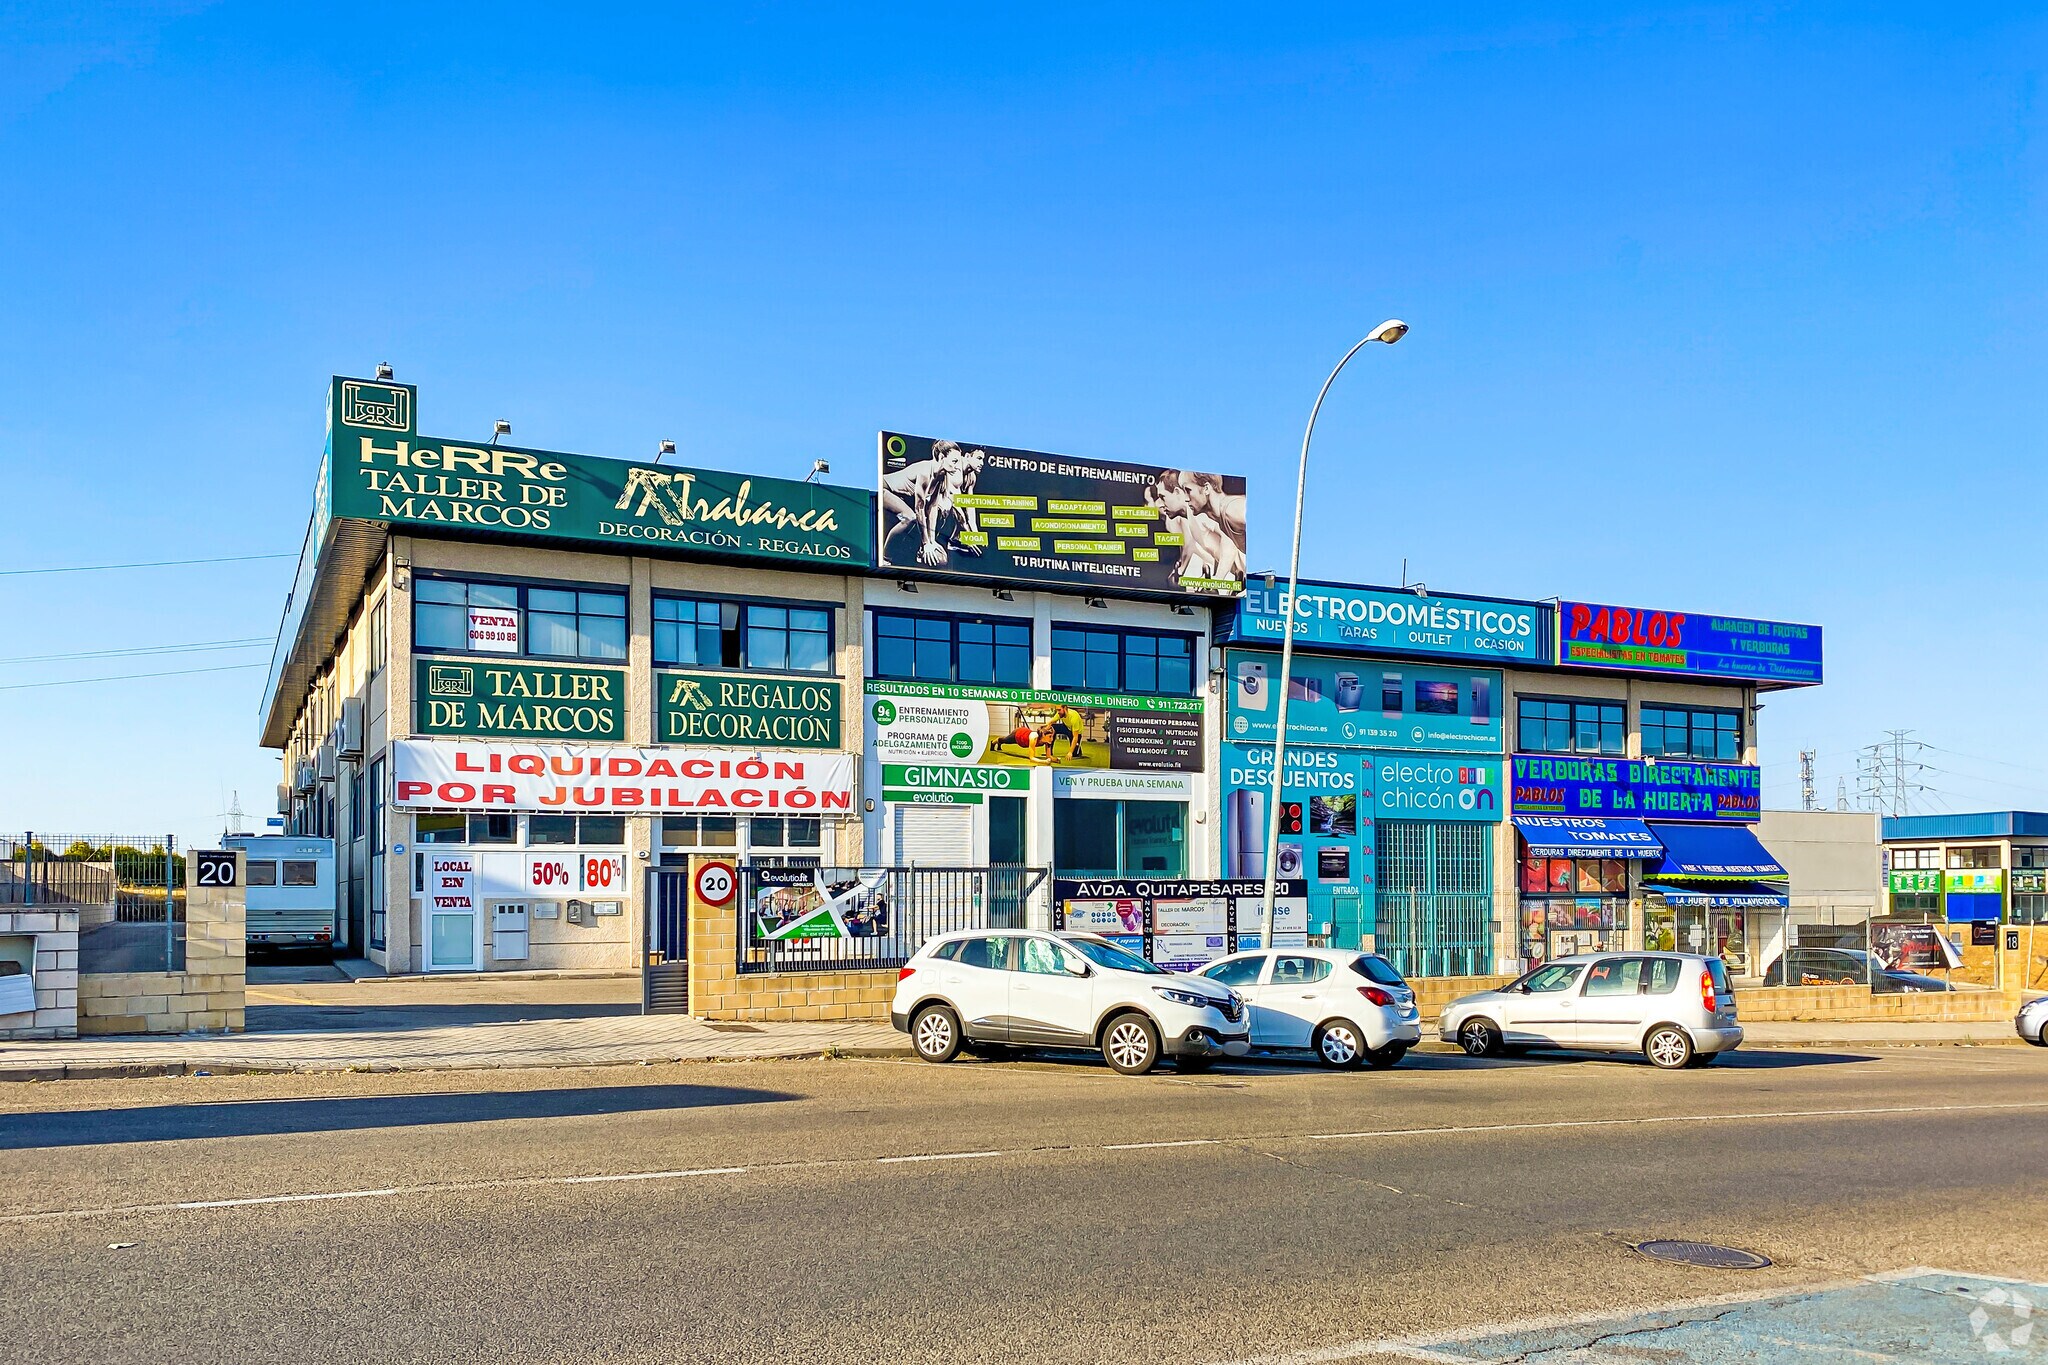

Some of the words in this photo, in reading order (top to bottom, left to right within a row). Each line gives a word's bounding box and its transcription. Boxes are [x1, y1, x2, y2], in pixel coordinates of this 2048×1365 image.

[359, 437, 568, 482] HeRRe
[988, 455, 1037, 472] CENTRO
[1039, 463, 1056, 474] DE
[1058, 464, 1155, 486] ENTRENAMIENTO
[360, 468, 507, 501] TALLER
[519, 484, 568, 508] DE
[956, 497, 1001, 507] FUNCTIONAL
[1002, 499, 1035, 508] TRAINING
[378, 494, 551, 530] MARCOS
[1114, 510, 1157, 518] KETTLEBELL
[982, 517, 1011, 526] FUERZA
[1118, 527, 1147, 535] PILATES
[598, 521, 742, 549] DECORACIÓN
[758, 538, 851, 559] REGALOS
[963, 534, 985, 543] YOGA
[1000, 540, 1038, 549] MOVILIDAD
[1056, 543, 1092, 551] PERSONAL
[1093, 544, 1123, 552] TRAINER
[1013, 555, 1028, 568] TU
[1031, 558, 1070, 571] RUTINA
[1072, 561, 1141, 578] INTELIGENTE
[1246, 589, 1531, 637] ELECTRODOMÉSTICOS
[470, 615, 516, 628] VENTA
[1569, 604, 1686, 649] PABLOS
[469, 629, 484, 640] 606
[485, 630, 496, 641] 99
[496, 631, 505, 641] 10
[506, 632, 517, 642] 88
[1758, 622, 1770, 636] DE
[1773, 624, 1808, 639] FRUTAS
[1338, 625, 1378, 640] TARAS
[1408, 631, 1453, 646] OUTLET
[1474, 636, 1524, 652] OCASIÓN
[1730, 638, 1738, 650] Y
[1740, 639, 1790, 656] VERDURAS
[485, 670, 613, 701] TALLER
[719, 682, 832, 712] REGALOS
[866, 683, 930, 696] RESULTADOS
[932, 688, 945, 697] EN
[947, 687, 959, 698] 10
[961, 688, 1008, 699] SEMANAS
[1011, 692, 1018, 700] O
[1020, 691, 1031, 701] TE
[1034, 691, 1093, 704] DEVOLVEMOS
[1095, 697, 1105, 706] EL
[1108, 697, 1139, 708] DINERO
[877, 705, 891, 718] 9€
[899, 706, 969, 718] ENTRENAMIENTO
[1158, 701, 1203, 711] 911.723.217
[428, 700, 467, 728] DE
[477, 702, 614, 733] MARCOS
[899, 715, 968, 726] PERSONALIZADO
[1116, 717, 1167, 725] ENTRENAMIENTO
[1168, 720, 1199, 728] PERSONAL
[668, 711, 832, 742] DECORACIÓN
[1116, 727, 1157, 736] FISIOTERAPIA
[1165, 729, 1199, 738] NUTRICIÓN
[1252, 722, 1328, 733] www.etrochicon.es
[887, 732, 935, 741] PROGRAMA
[937, 734, 948, 742] DE
[1389, 730, 1398, 738] 20
[872, 740, 948, 750] ADELGAZAMIENTO
[1118, 737, 1164, 746] CARDIOBOXING
[1247, 748, 1338, 769] GRNDES
[455, 751, 804, 781] LIQUIDACIÓN
[1381, 761, 1454, 784] electro
[904, 766, 1011, 789] GIMNASIO
[1515, 758, 1618, 783] VERDURAS
[1630, 763, 1760, 789] DIRECTAMENTE
[1058, 777, 1077, 786] VEN
[1079, 777, 1086, 787] Y
[1087, 777, 1123, 788] PRUEBA
[1125, 778, 1145, 788] UNA
[1146, 779, 1184, 789] SEMANA
[397, 780, 516, 804] POR
[538, 785, 851, 809] JUBILACIÓN
[912, 792, 954, 804] evolutio
[1381, 786, 1454, 810] chicón
[1515, 785, 1567, 804] PABLOS
[1579, 788, 1603, 808] DE
[1613, 789, 1636, 809] LA
[1643, 790, 1714, 813] HUERTA
[1717, 793, 1760, 810] PABLOS
[1515, 816, 1607, 829] NUESTROS
[1567, 830, 1653, 842] TOMATES
[1530, 848, 1564, 857] VERDURAS
[1567, 848, 1612, 857] DIRECTAMENTE
[1614, 849, 1624, 857] DE
[1626, 849, 1635, 858] LA
[199, 862, 235, 884] 20
[433, 861, 472, 872] LOCAL
[586, 858, 621, 888] 80%
[532, 862, 569, 886] 50%
[770, 872, 808, 882] evolutio.fit
[442, 877, 464, 888] EN
[705, 877, 728, 891] 20
[1136, 882, 1264, 897] QUITAPESARES
[1274, 882, 1289, 895] 20
[1332, 886, 1359, 895] ENTRADA
[434, 897, 472, 908] VENTA
[1675, 897, 1685, 905] LA
[1719, 897, 1729, 905] DE
[1732, 896, 1780, 905] VILLAVICIOSA
[1144, 900, 1152, 925] NAVE
[1228, 899, 1236, 923] NAVE
[2007, 936, 2018, 949] 18
